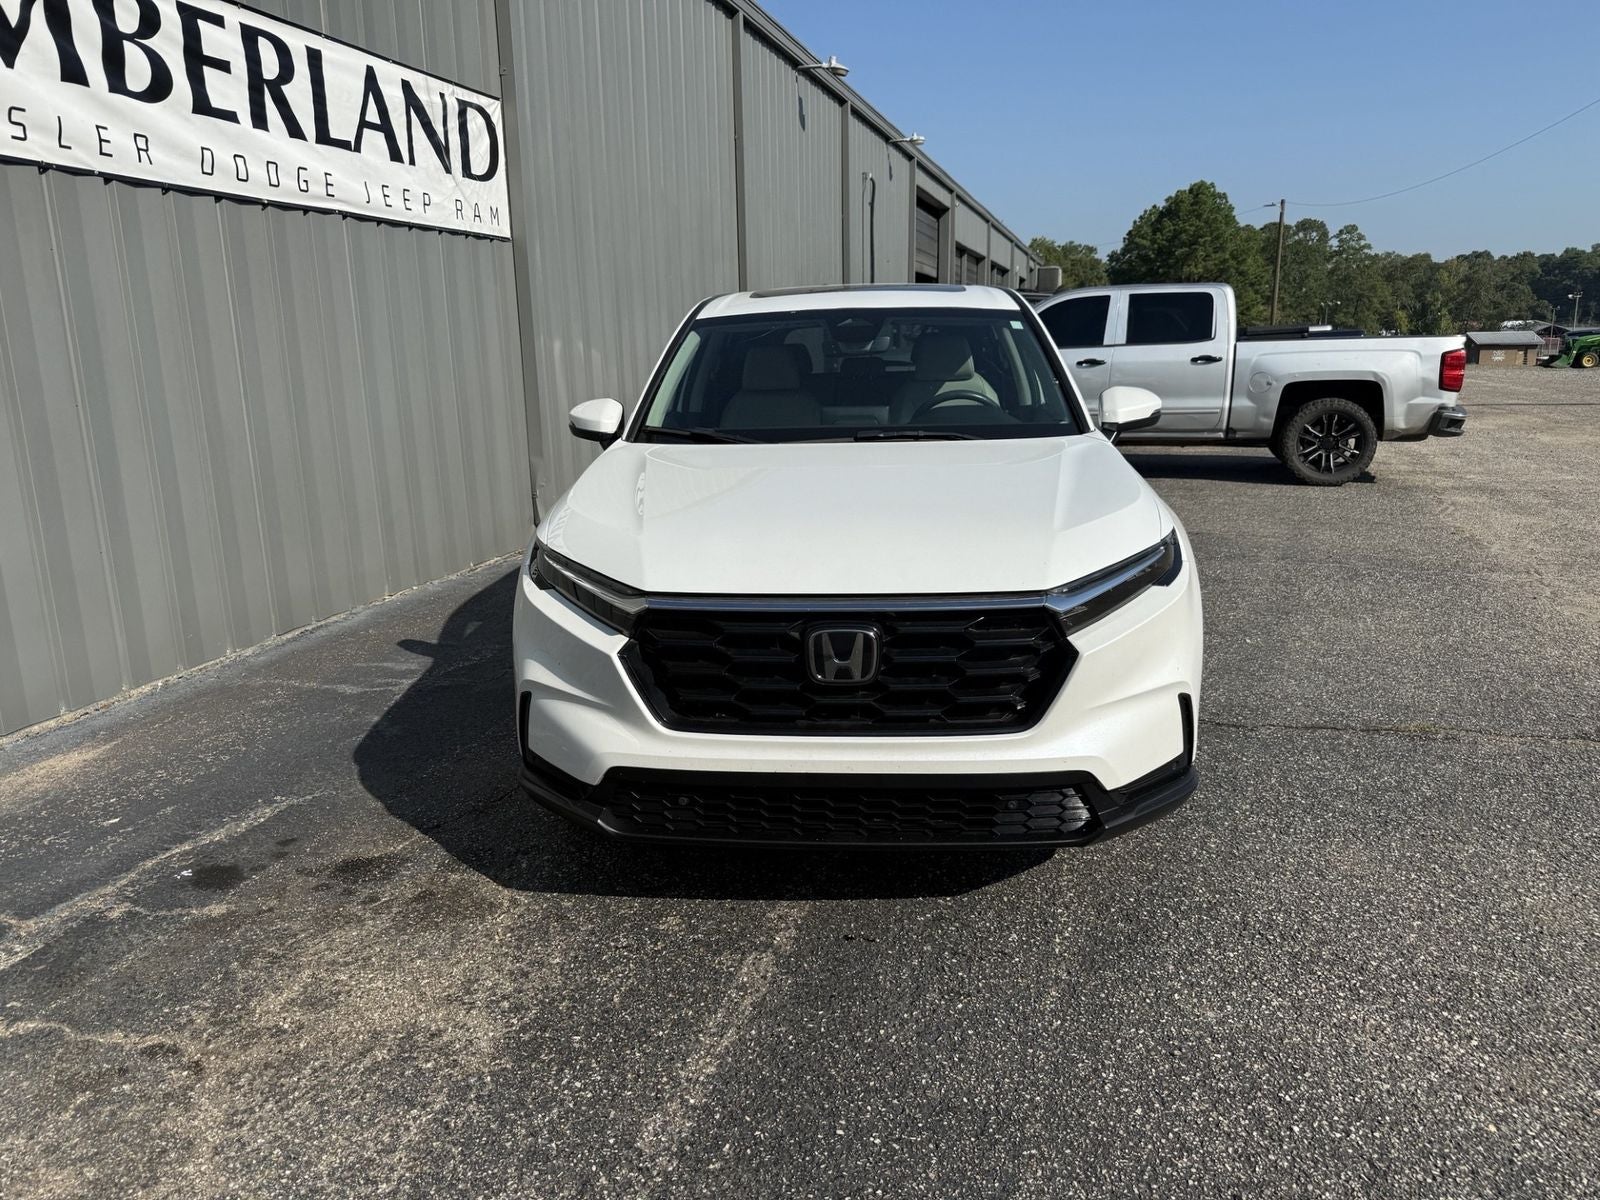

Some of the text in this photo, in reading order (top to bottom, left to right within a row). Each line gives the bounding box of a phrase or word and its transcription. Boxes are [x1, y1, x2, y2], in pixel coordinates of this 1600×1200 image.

[8, 106, 500, 227] SLER DODGE JEEP RAM
